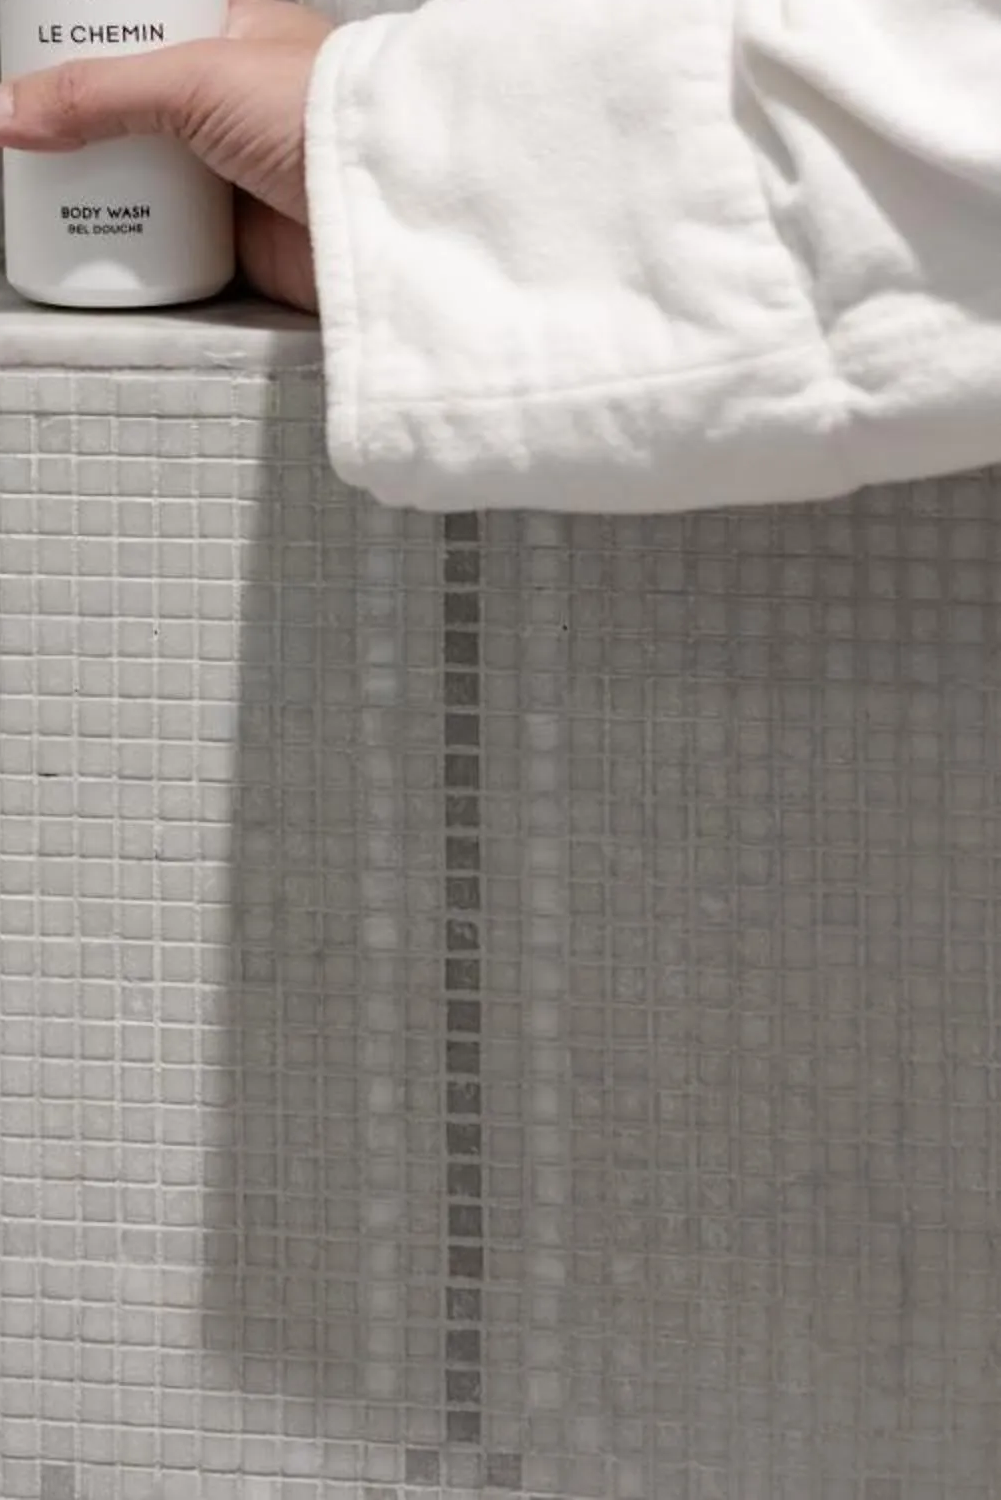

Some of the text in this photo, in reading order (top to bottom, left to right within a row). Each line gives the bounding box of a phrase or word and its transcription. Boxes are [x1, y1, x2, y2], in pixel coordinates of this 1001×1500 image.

[38, 22, 165, 45] LE CHEMIN
[60, 205, 151, 219] BODY WASH
[93, 223, 144, 234] DOUCHE
